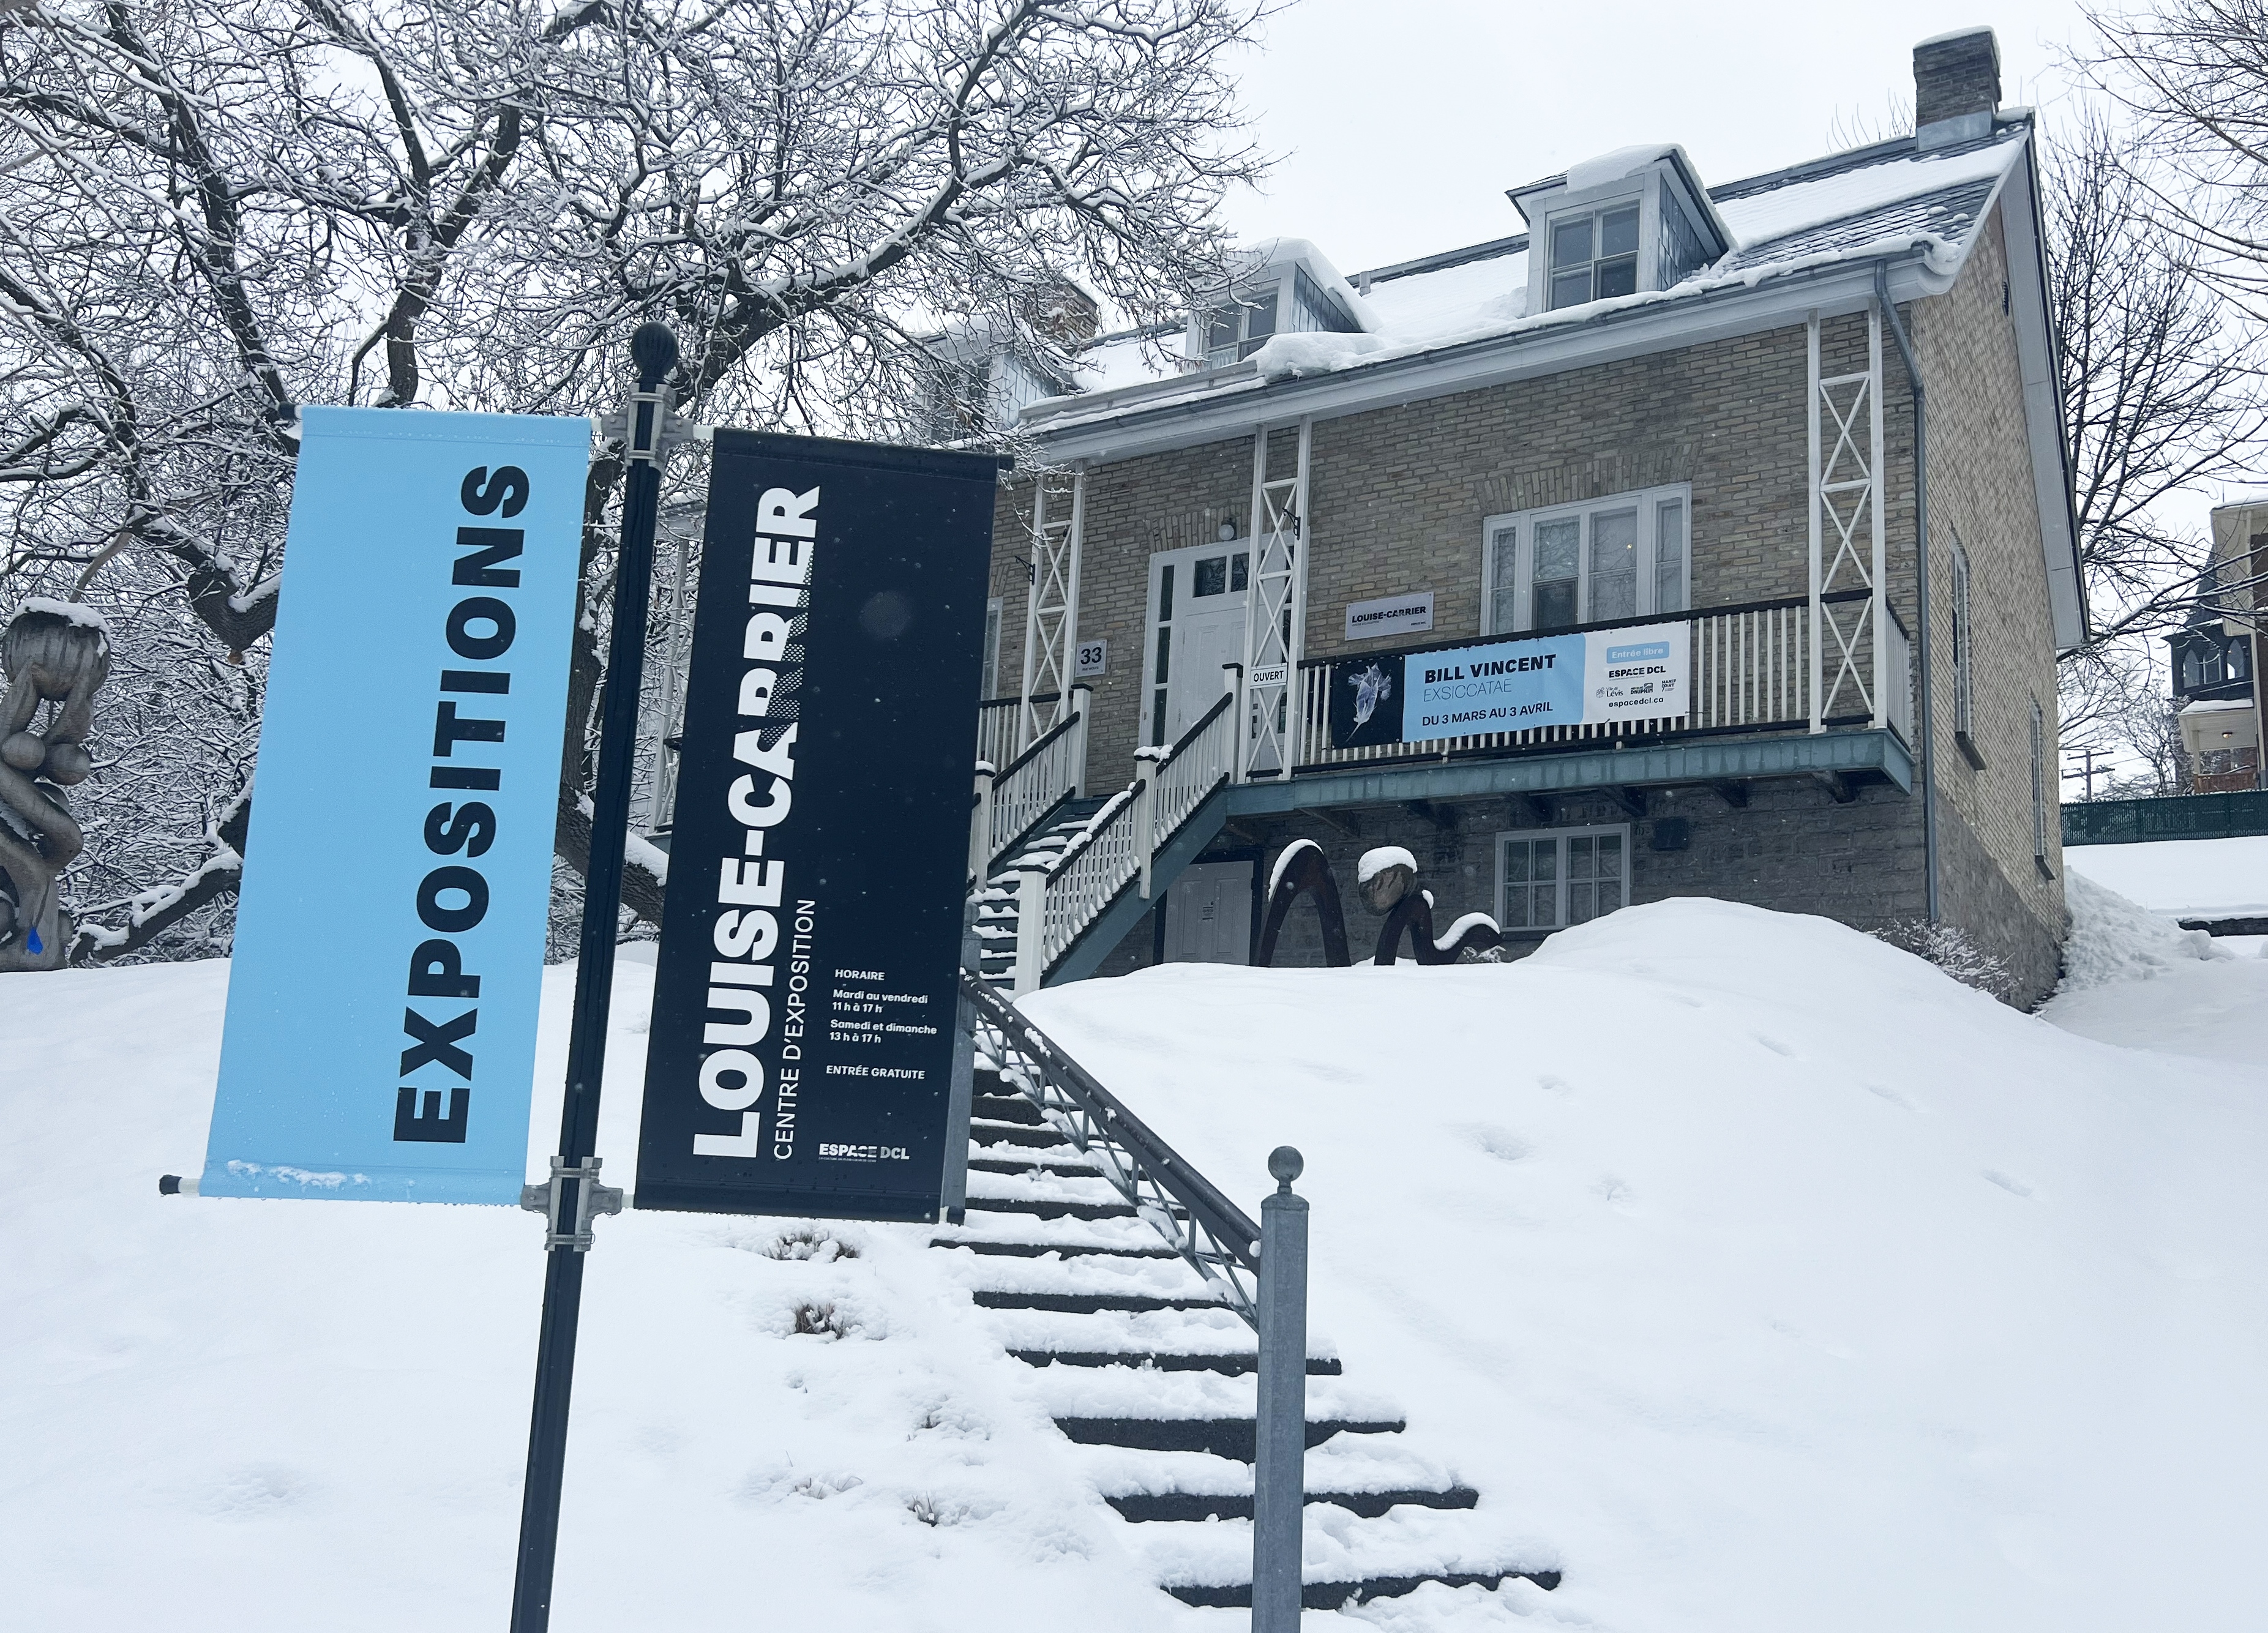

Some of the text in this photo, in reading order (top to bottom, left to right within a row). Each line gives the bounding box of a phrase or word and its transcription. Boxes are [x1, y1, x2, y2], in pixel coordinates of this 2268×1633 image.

[1352, 606, 1426, 623] LOUISE-CARRIER
[1080, 646, 1102, 665] 33
[1612, 649, 1641, 659] Entrée
[1254, 670, 1284, 682] OUVERT
[1424, 654, 1556, 684] BILL VINCENT
[1609, 667, 1645, 678] ESPACE
[1647, 665, 1666, 674] DCL
[1423, 678, 1512, 702] EXSICCATAE
[1609, 697, 1664, 708] espacedcl.ca
[1422, 701, 1554, 726] DU 3 MARS AU 3 AVRIL
[393, 466, 530, 1143] EXPOSITIONS
[693, 485, 821, 1159] LOUISE-CARRIER
[835, 969, 885, 981] HORAIRE
[833, 989, 865, 1000] Mardi
[881, 994, 929, 1004] vendredi
[832, 1002, 883, 1013] 11 h à 17 h
[774, 900, 816, 1160] CENTRE D'EXPOSITION
[830, 1019, 937, 1034] Samedi et dimanche
[829, 1031, 881, 1043] 13 h à 17 h
[826, 1065, 926, 1079] ENTRÉE GRATUITE
[819, 1143, 878, 1158] ESPACE
[880, 1146, 910, 1160] DCL
